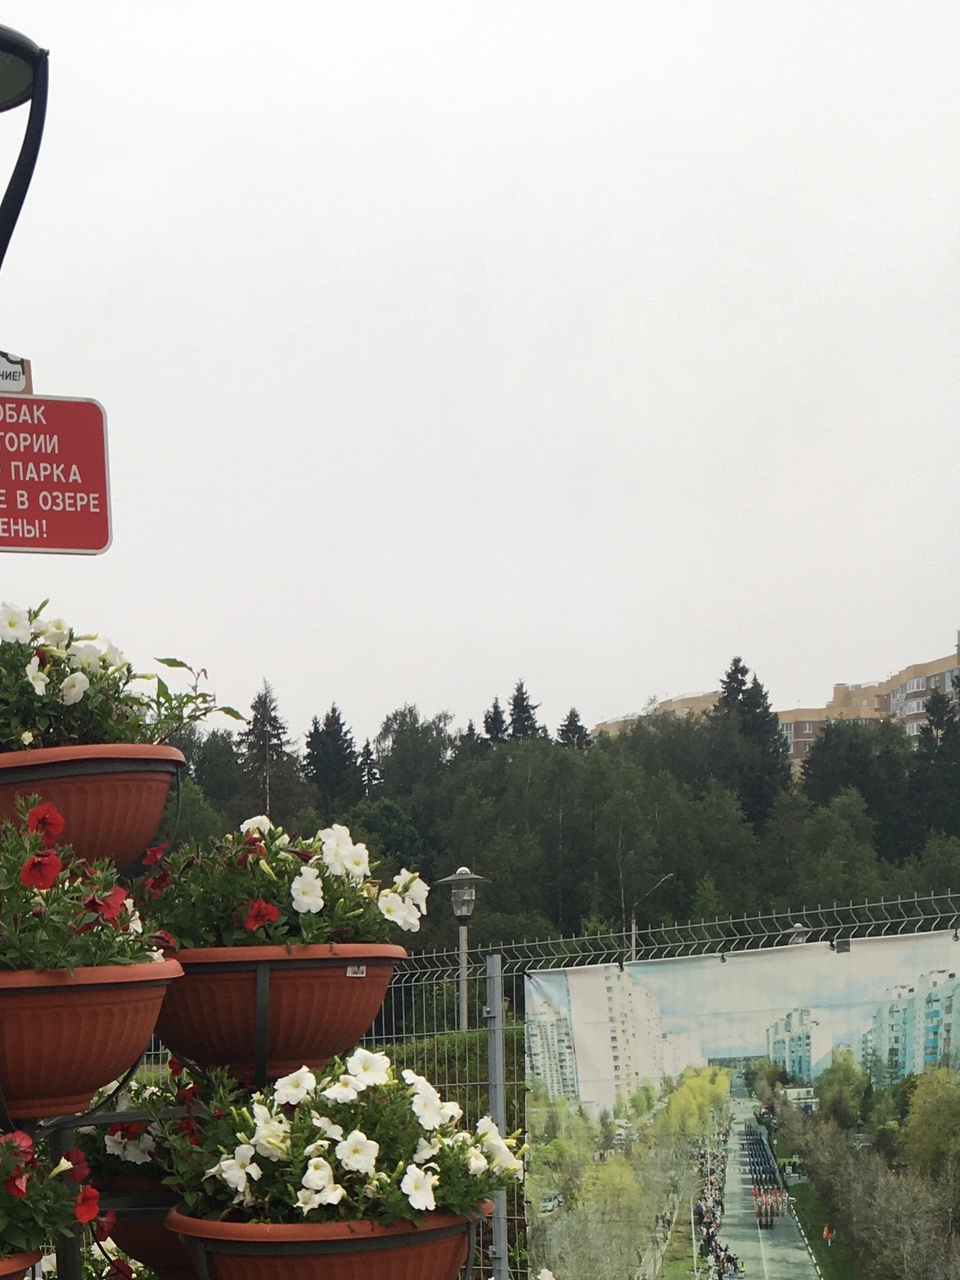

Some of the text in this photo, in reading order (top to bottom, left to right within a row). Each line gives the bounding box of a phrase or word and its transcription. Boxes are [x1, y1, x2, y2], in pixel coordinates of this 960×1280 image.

[10, 461, 82, 483] ПАРКА
[16, 490, 29, 510] В
[39, 491, 100, 512] ОЗЕРЕ
